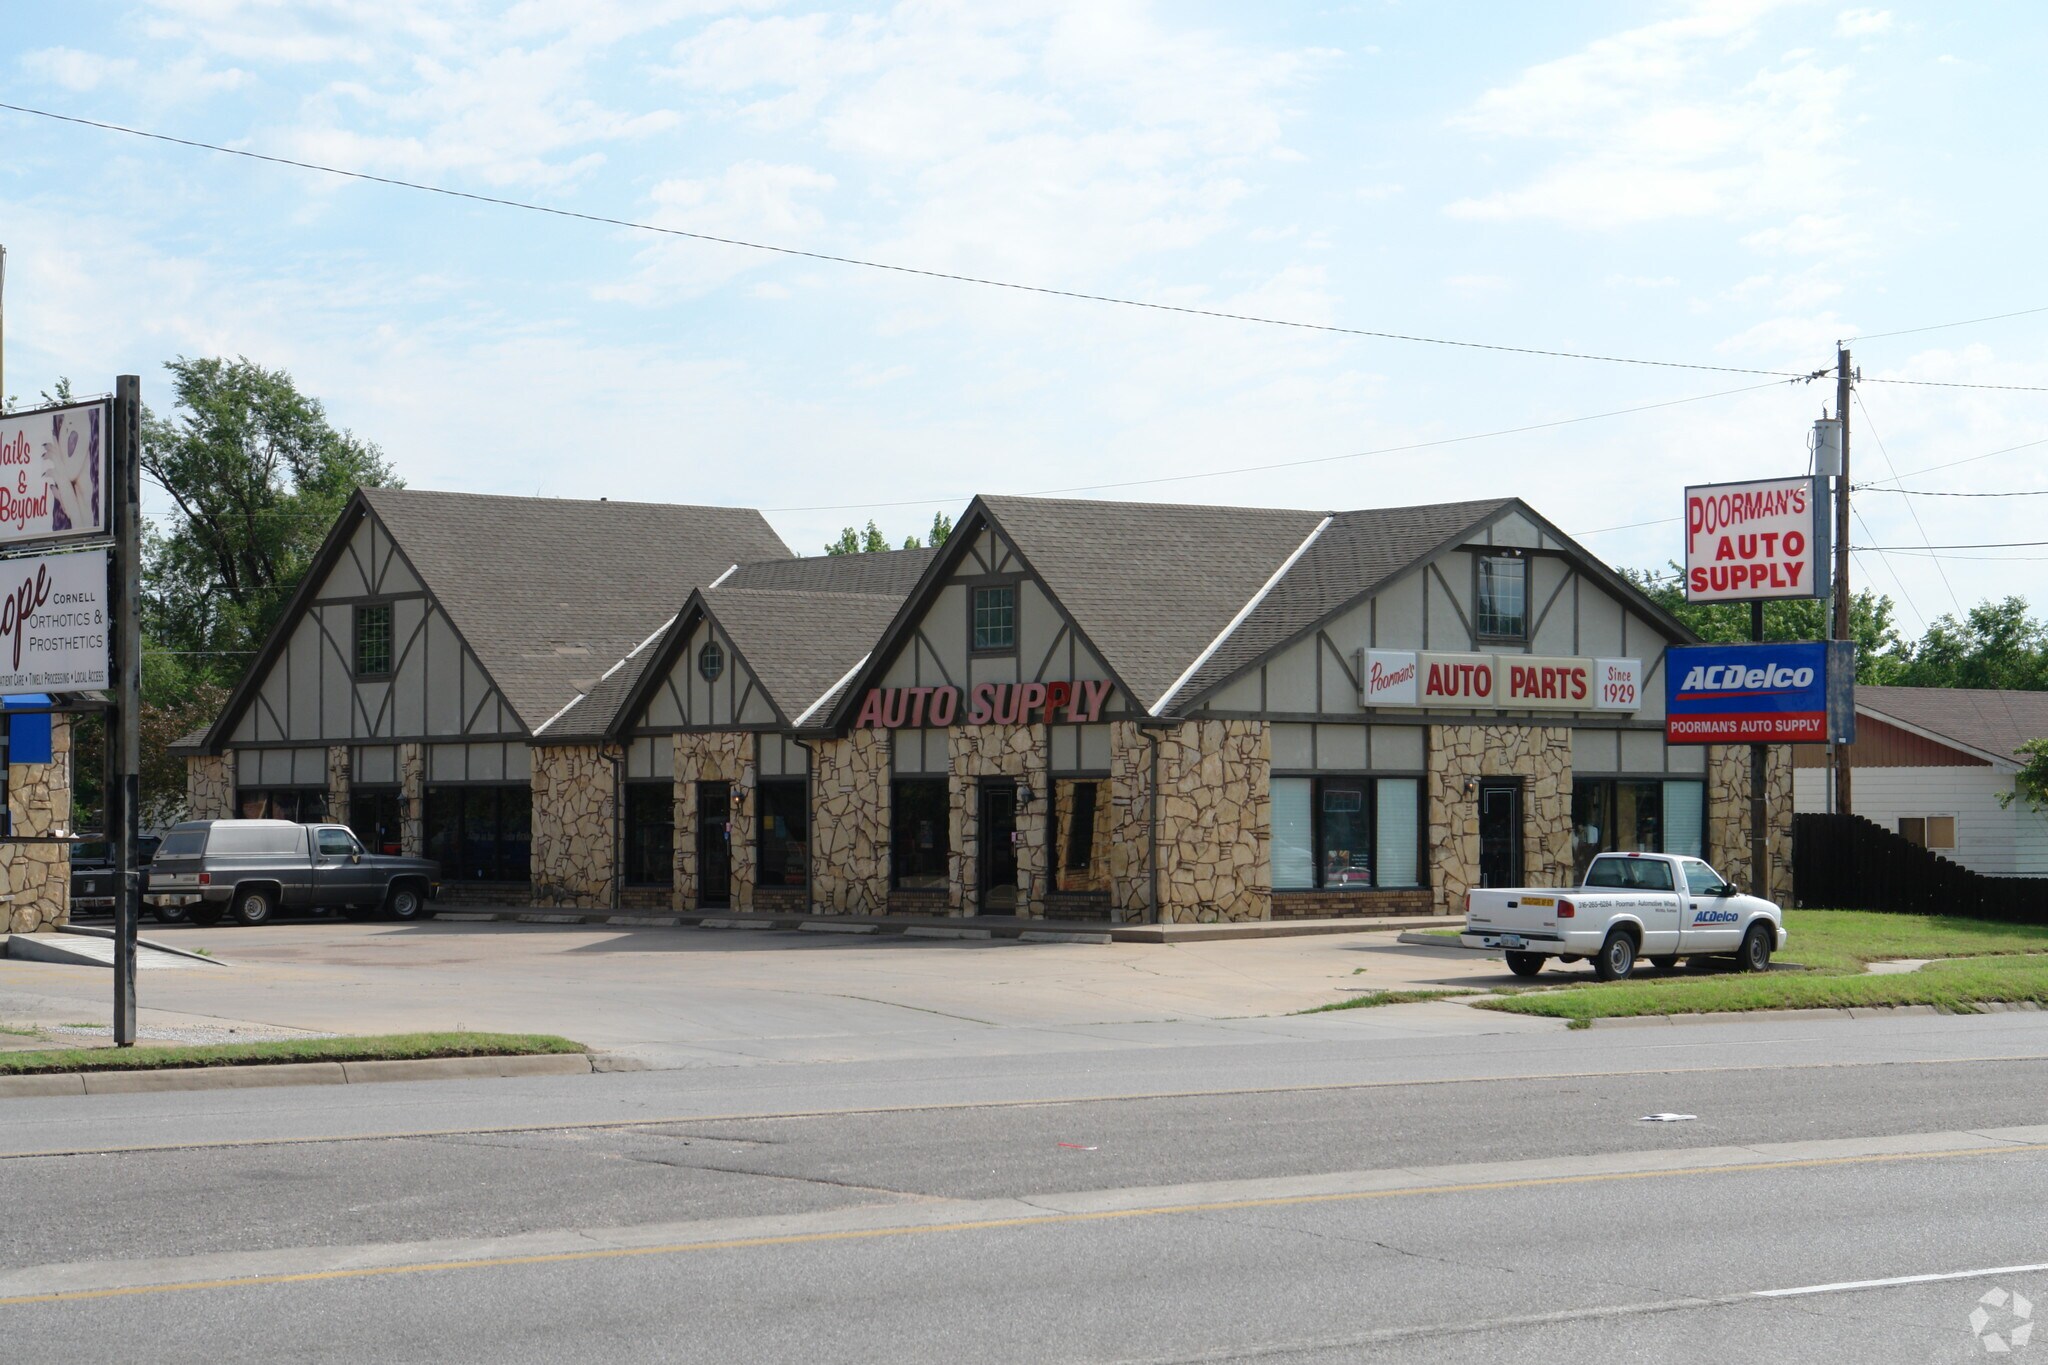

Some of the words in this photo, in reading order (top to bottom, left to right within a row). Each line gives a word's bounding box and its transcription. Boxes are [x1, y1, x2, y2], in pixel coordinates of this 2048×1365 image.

[18, 469, 27, 494] &
[0, 482, 47, 530] Beyond
[1689, 490, 1805, 554] POORMAN'S
[1715, 531, 1804, 561] AUTO
[1690, 562, 1804, 592] SUPPLY
[53, 592, 95, 604] CORNELL
[30, 613, 90, 628] ORTHOTICS
[94, 609, 103, 625] &
[29, 635, 103, 651] PROSTHETICS
[1370, 661, 1415, 694] Poorman's
[1426, 662, 1492, 697] AUTO
[1511, 665, 1587, 700] PARTS
[1608, 666, 1632, 682] Since
[1681, 663, 1814, 690] ACDelco
[856, 686, 958, 728] AUTO
[968, 680, 1112, 725] SUPPLY
[1604, 684, 1635, 704] 1929
[1671, 720, 1737, 733] POORMAN'S
[1740, 720, 1772, 732] AUTO
[1775, 719, 1820, 732] SUPPLY
[1695, 911, 1739, 922] ACDelco
